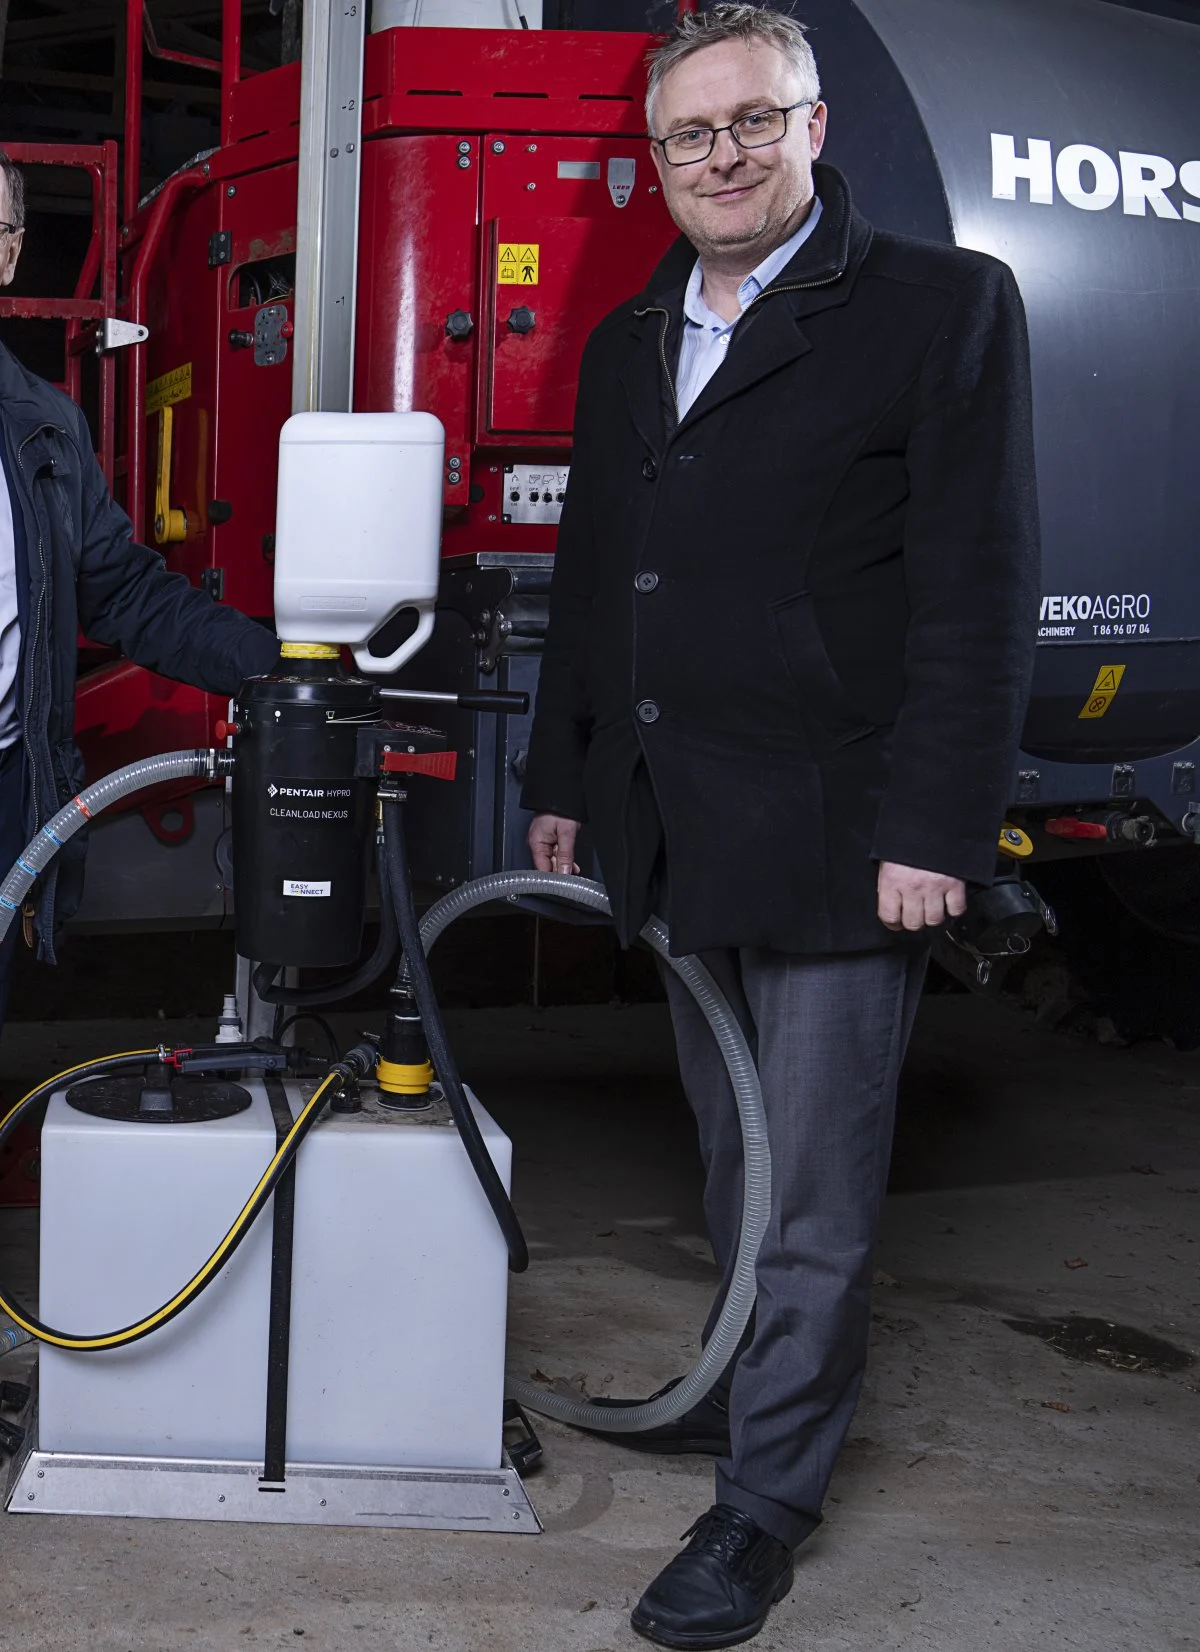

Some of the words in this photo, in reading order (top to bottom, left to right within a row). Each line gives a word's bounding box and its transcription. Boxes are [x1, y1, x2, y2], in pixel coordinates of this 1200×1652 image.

[1092, 625, 1099, 636] T
[1100, 624, 1111, 635] 86
[1113, 624, 1124, 635] 96
[1126, 623, 1137, 634] 07
[1139, 623, 1150, 634] 04
[279, 787, 325, 798] PENTAIR
[326, 789, 351, 797] HYPRO
[269, 807, 320, 819] CLEANLOAD
[321, 810, 349, 819] NEXUS
